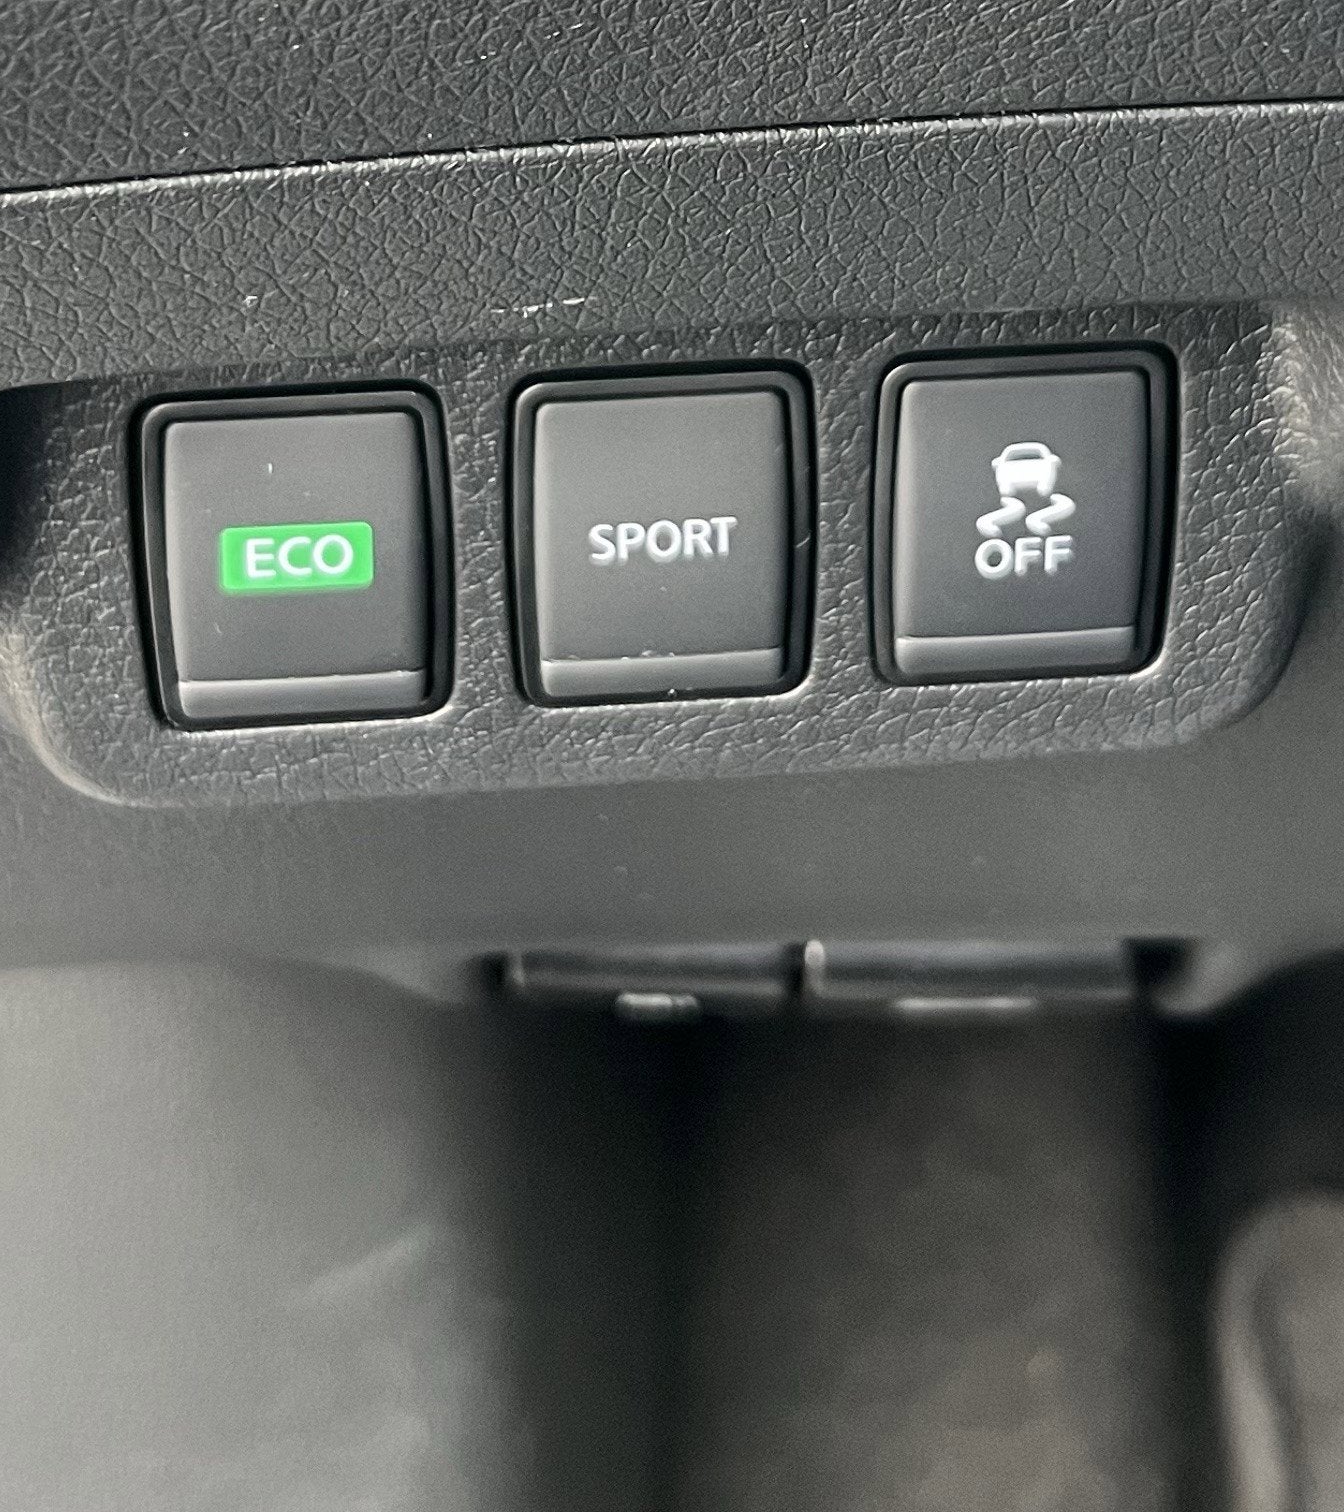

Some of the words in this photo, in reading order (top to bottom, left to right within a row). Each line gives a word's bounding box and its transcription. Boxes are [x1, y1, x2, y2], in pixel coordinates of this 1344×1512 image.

[244, 534, 353, 578] ECO
[588, 516, 736, 564] SPORT
[974, 535, 1073, 578] OFF
